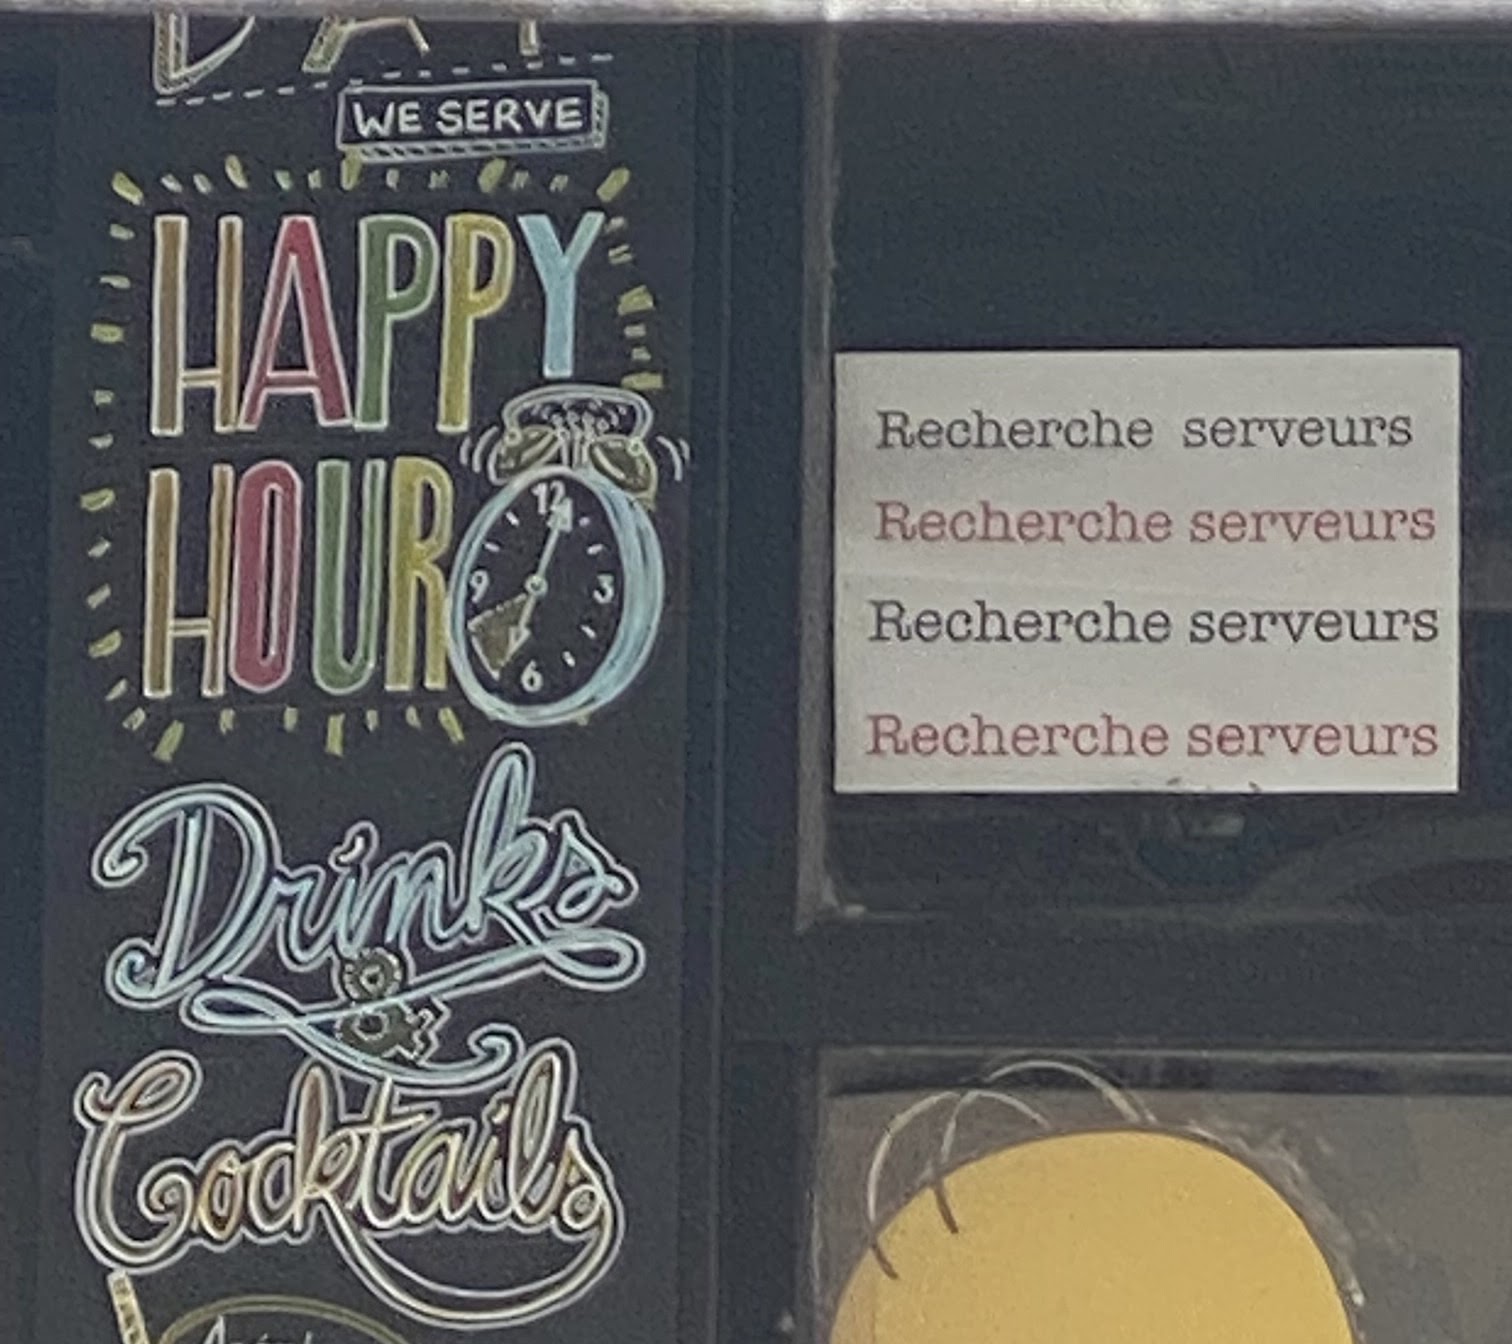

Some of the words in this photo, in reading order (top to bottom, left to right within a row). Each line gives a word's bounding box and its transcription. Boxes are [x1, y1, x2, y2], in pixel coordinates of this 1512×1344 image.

[352, 102, 423, 138] WE
[436, 96, 583, 134] SERVE
[150, 211, 606, 434] HAPPY
[875, 409, 1154, 451] Recherche
[1181, 413, 1414, 449] serveurs
[873, 500, 1173, 544] Recherche
[1188, 506, 1438, 543] serveurs
[142, 456, 454, 698] HOUR
[469, 570, 490, 604] 9
[592, 573, 615, 604] 3
[867, 600, 1173, 645] Recherche
[1188, 606, 1440, 643] serveurs
[520, 659, 544, 692] 6
[863, 712, 1171, 758] Recherche
[1186, 720, 1440, 758] serveurs
[92, 742, 646, 1085] Drinks
[75, 1038, 625, 1326] Cocktails
